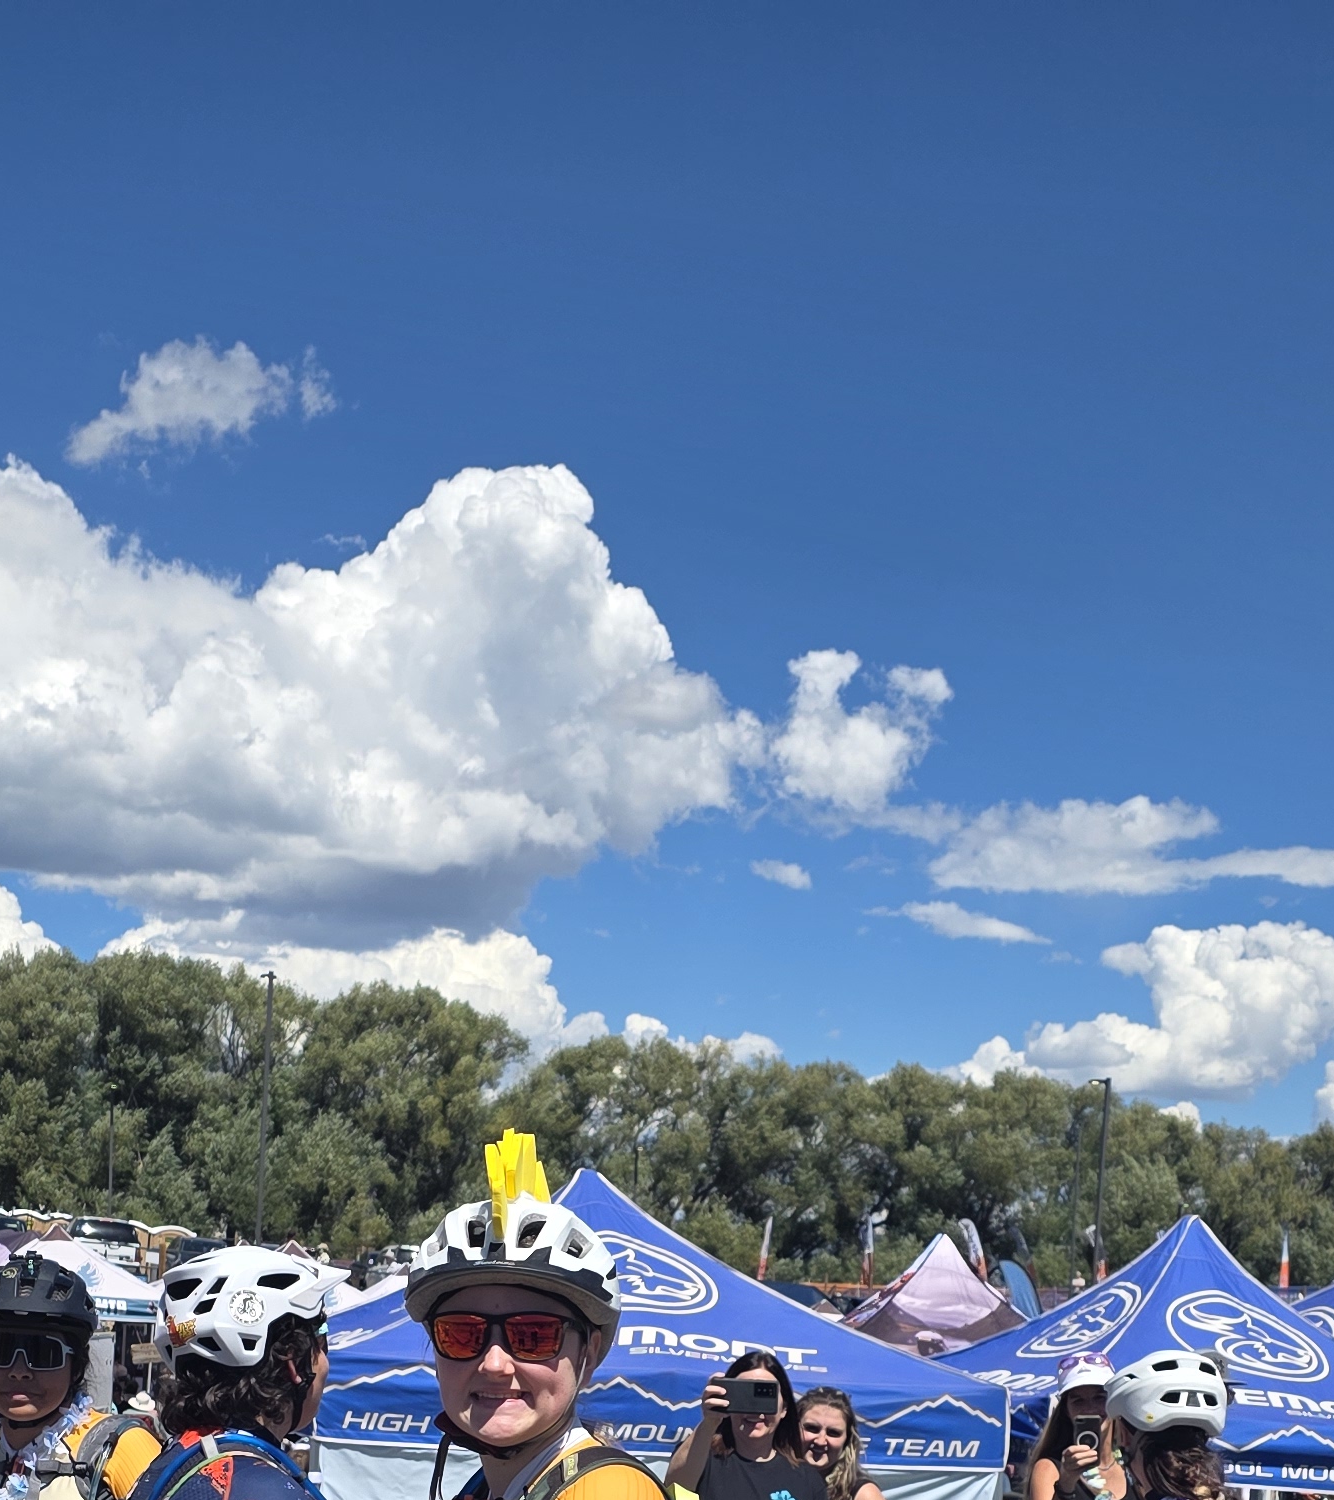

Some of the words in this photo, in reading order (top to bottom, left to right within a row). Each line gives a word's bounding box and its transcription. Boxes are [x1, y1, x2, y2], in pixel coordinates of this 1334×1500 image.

[629, 1347, 828, 1373] SILVERWVES
[342, 1410, 431, 1434] HIGH
[885, 1438, 980, 1458] TEAM
